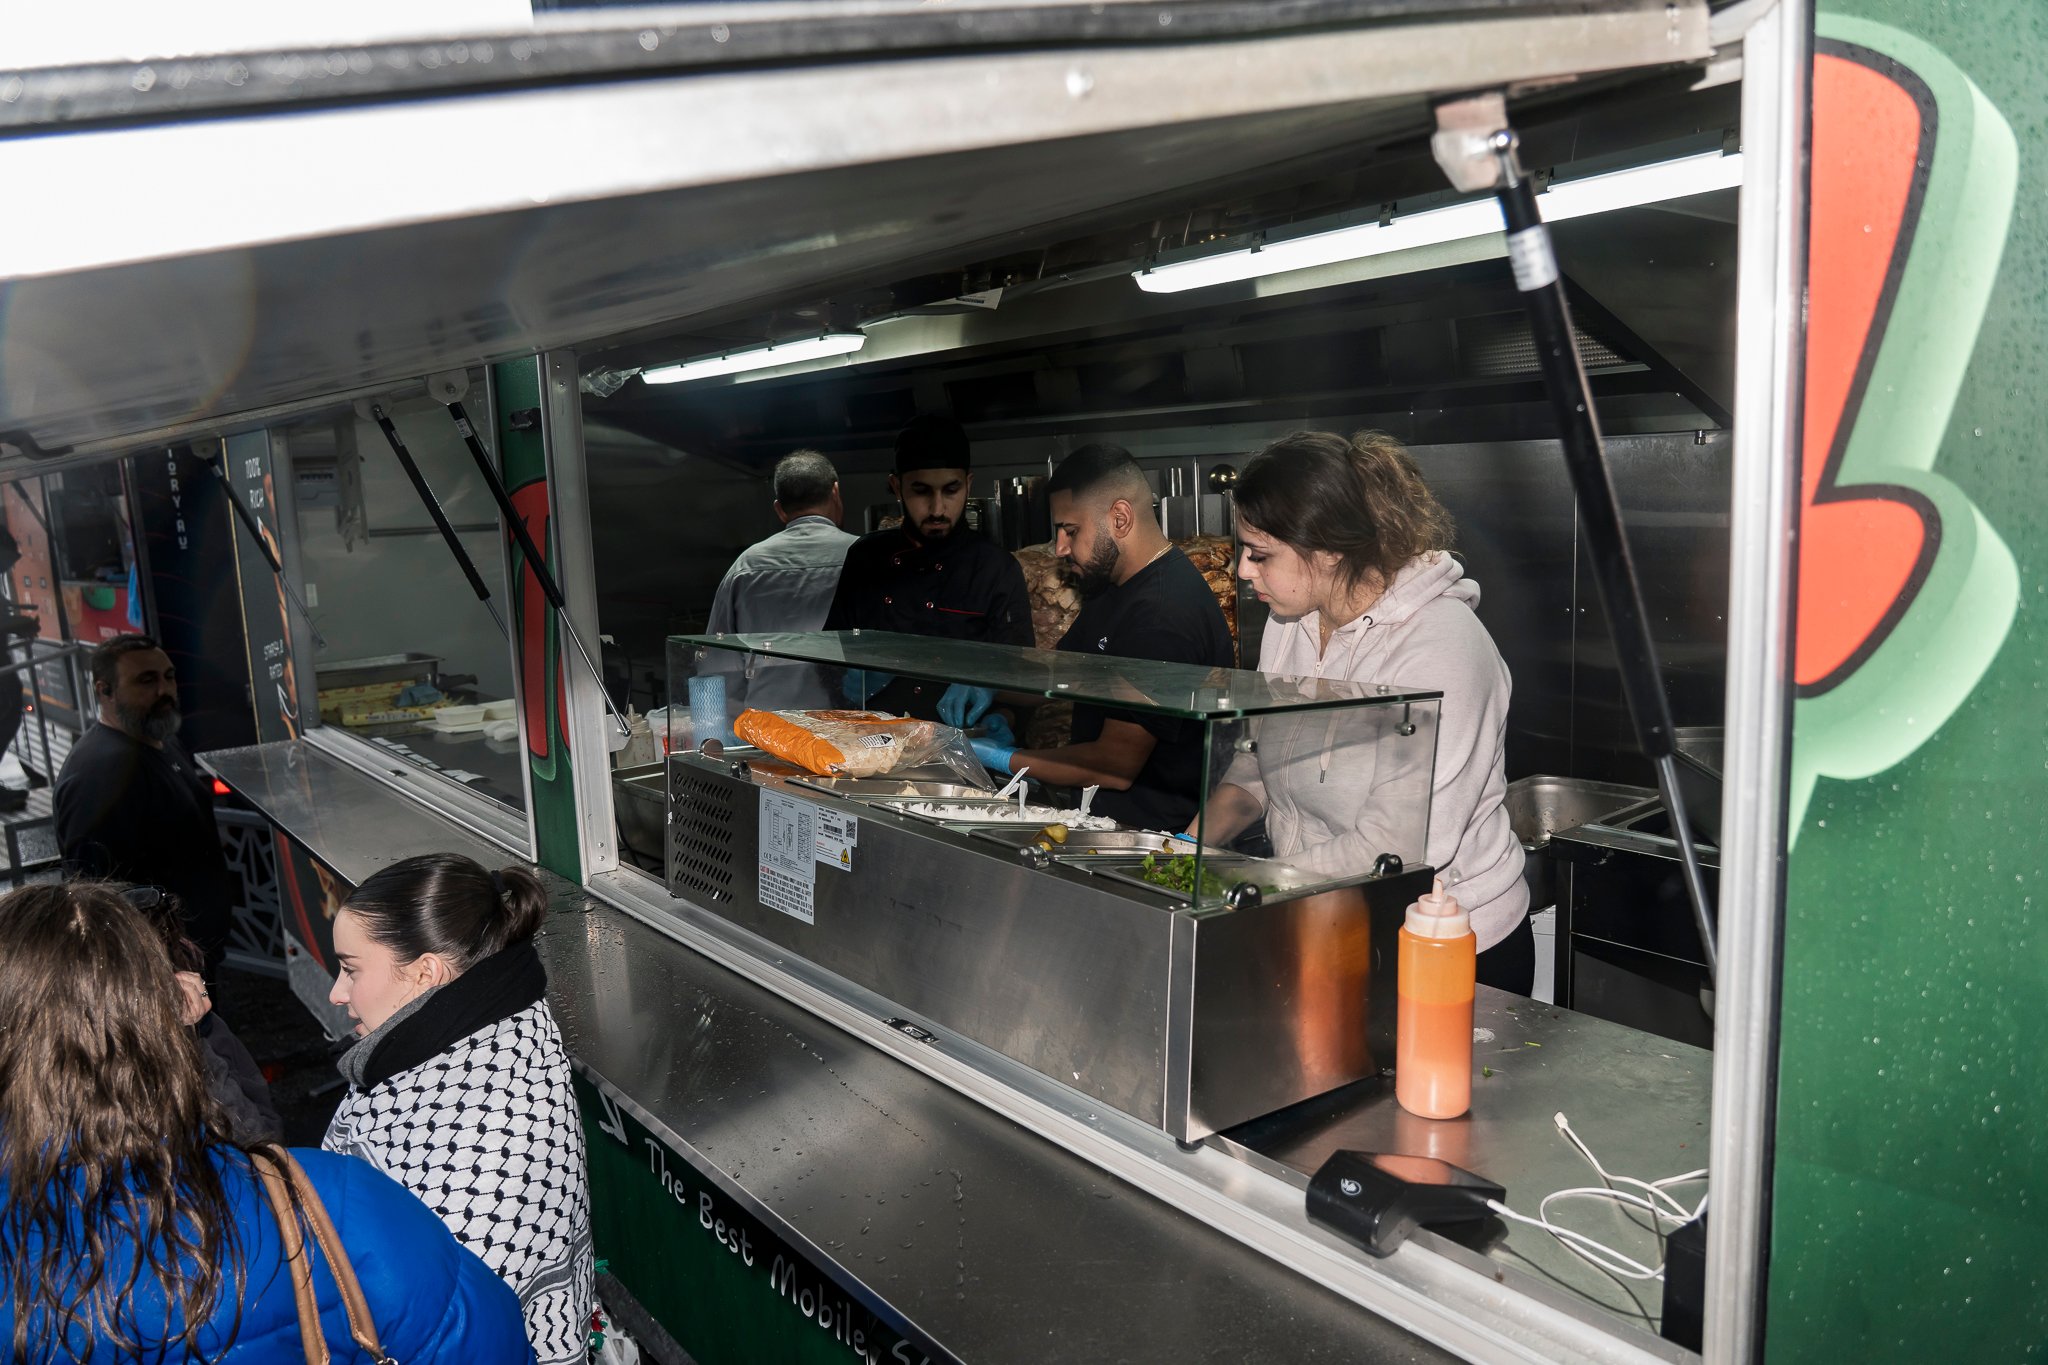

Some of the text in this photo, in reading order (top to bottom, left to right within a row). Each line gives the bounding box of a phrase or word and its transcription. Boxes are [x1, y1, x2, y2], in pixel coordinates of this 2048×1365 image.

[244, 457, 262, 479] 100%
[643, 1138, 686, 1204] The
[699, 1191, 753, 1267] Best
[769, 1253, 868, 1357] Mobile
